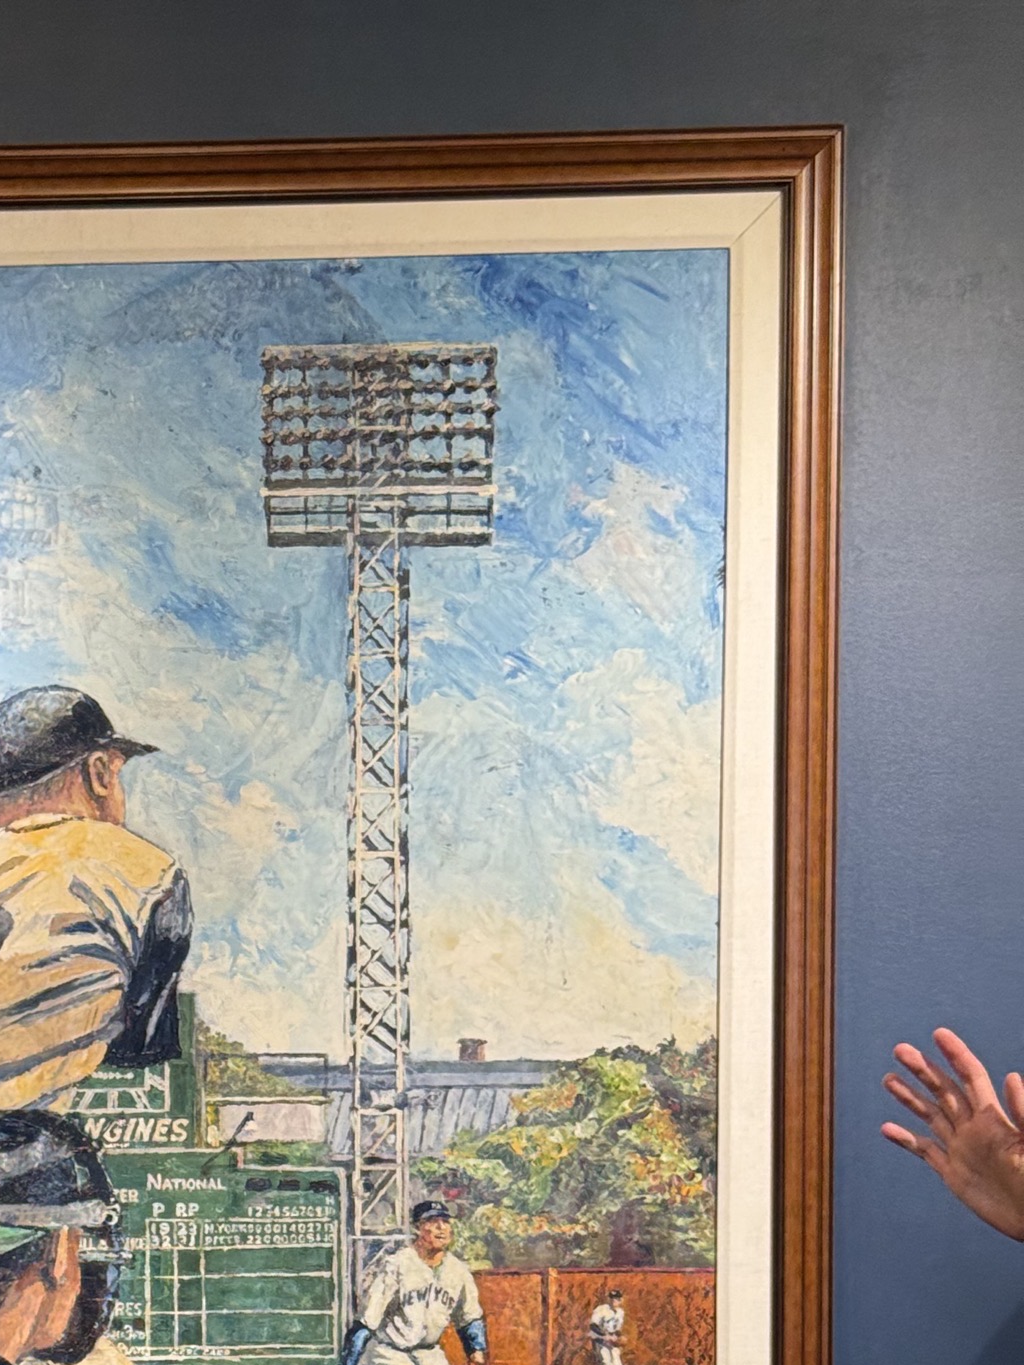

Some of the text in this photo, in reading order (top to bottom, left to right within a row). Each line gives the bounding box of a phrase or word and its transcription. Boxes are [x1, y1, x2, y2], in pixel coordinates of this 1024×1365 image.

[147, 1173, 226, 1191] NATIONAL
[152, 1202, 199, 1217] P RP
